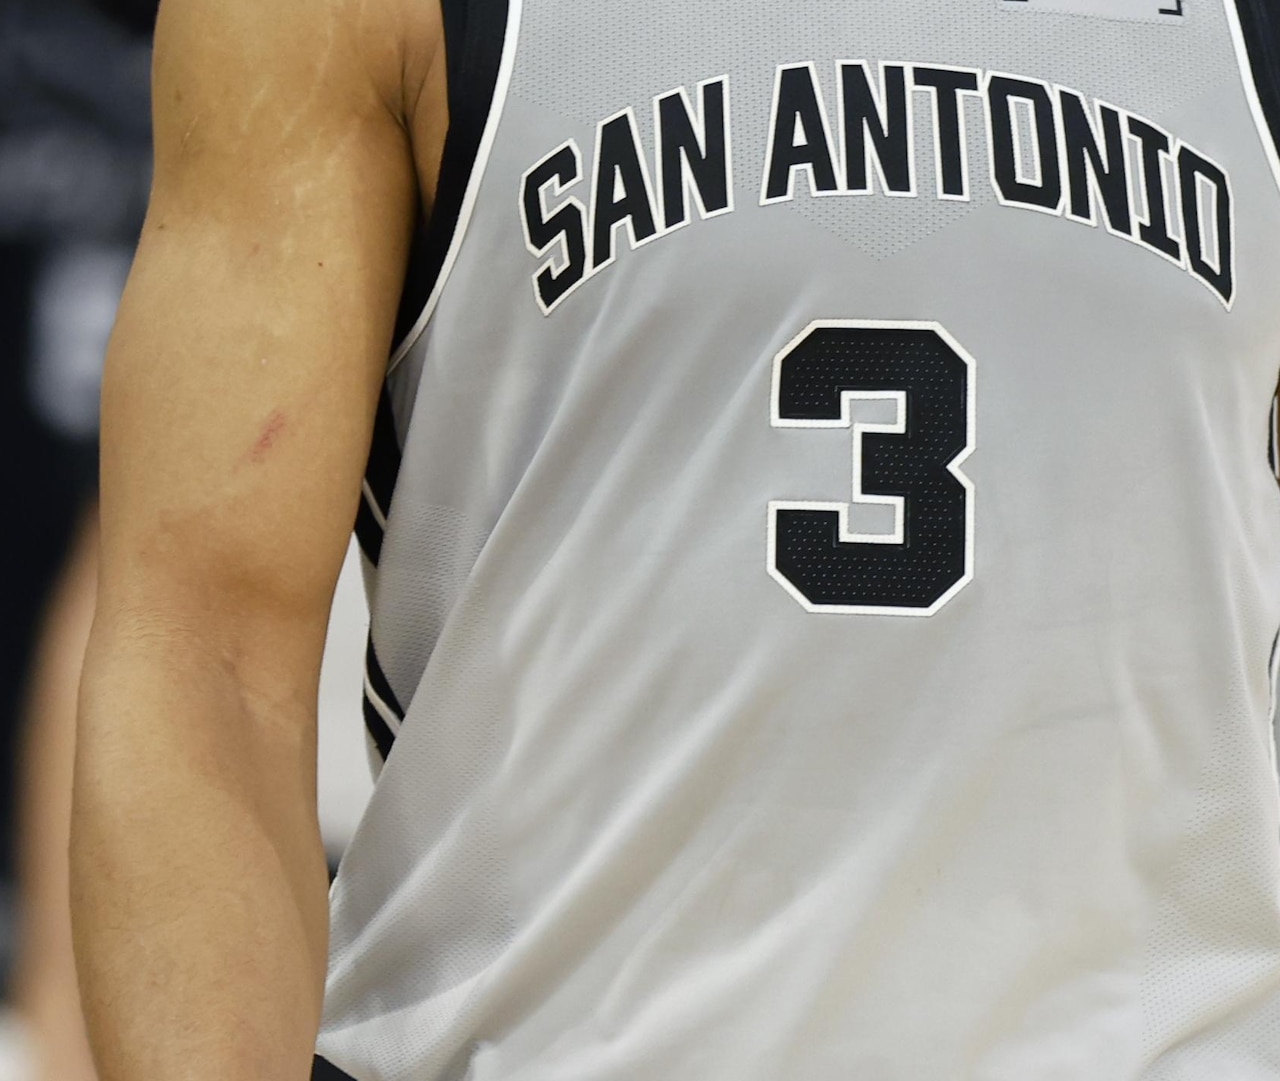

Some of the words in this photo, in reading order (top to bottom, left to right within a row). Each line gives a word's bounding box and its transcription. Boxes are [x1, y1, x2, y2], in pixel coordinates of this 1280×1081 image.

[521, 74, 734, 316] SAN
[760, 58, 1235, 312] ANTONIO
[767, 319, 976, 617] 3
